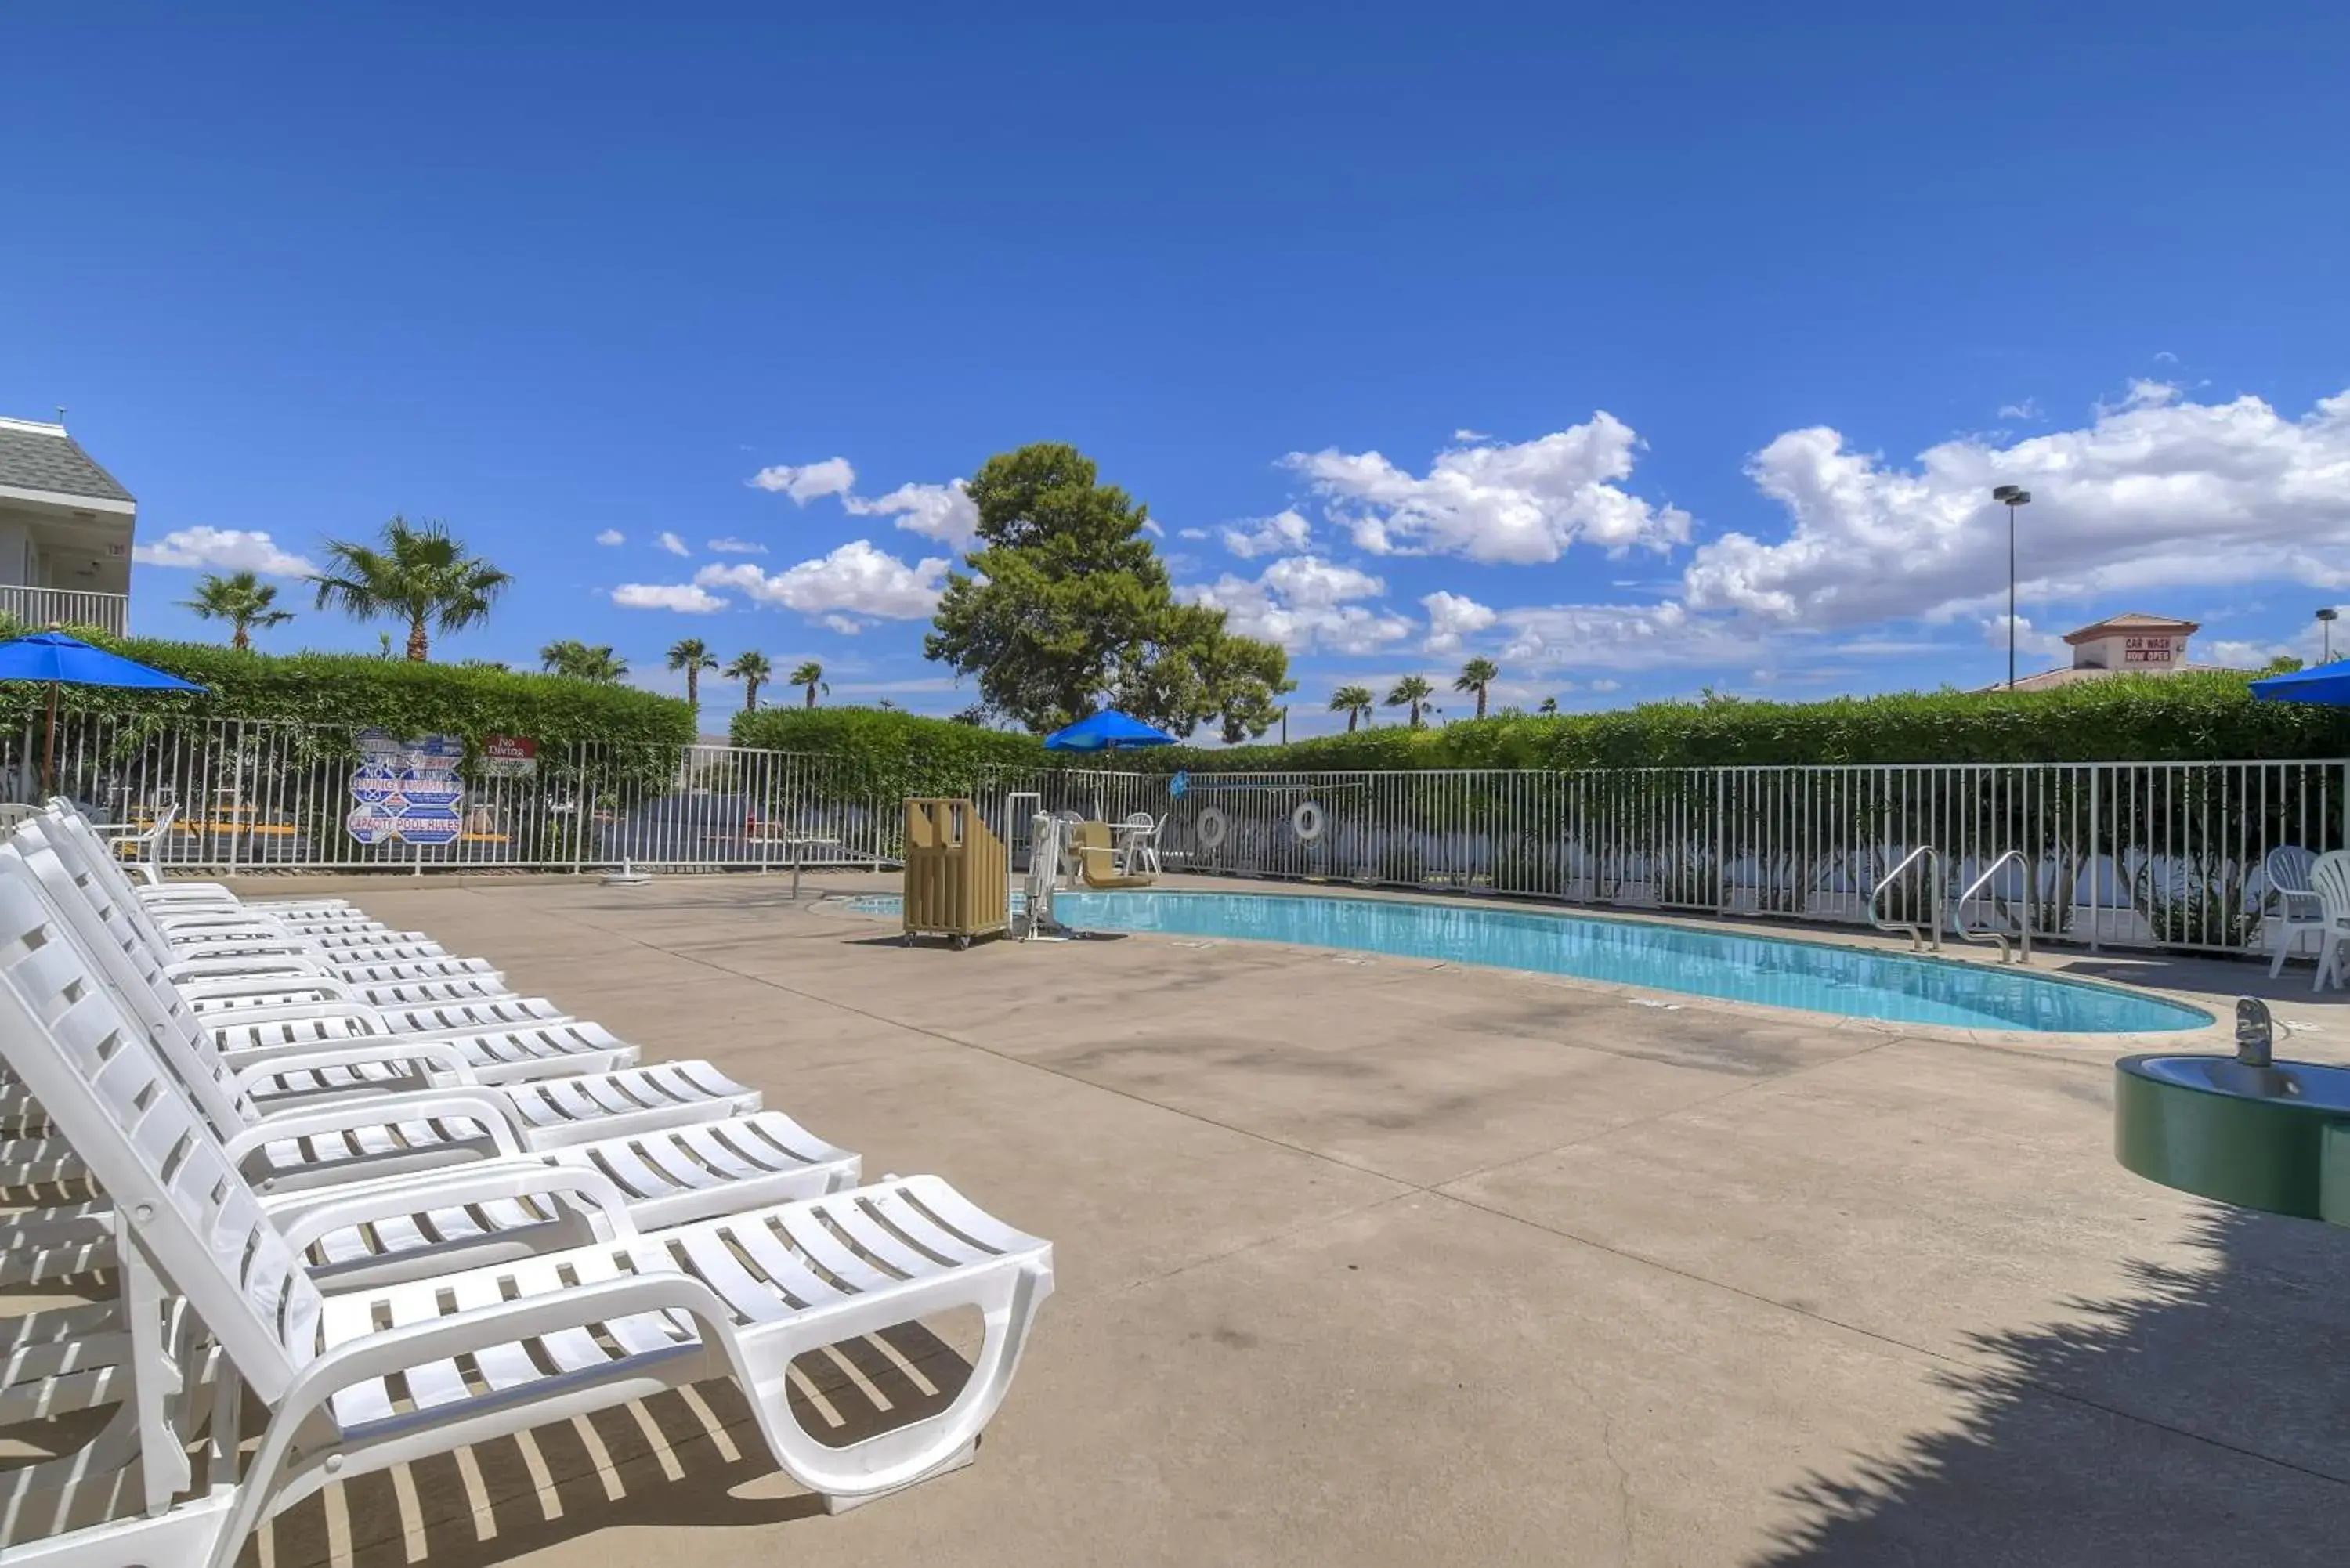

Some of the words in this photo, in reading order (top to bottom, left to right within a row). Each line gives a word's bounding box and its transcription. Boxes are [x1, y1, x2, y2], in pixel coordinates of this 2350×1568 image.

[2126, 638, 2142, 649] CAR
[2147, 638, 2170, 649] WASH
[2149, 652, 2169, 660] OPEN
[499, 738, 515, 747] No
[488, 745, 524, 757] Diving
[366, 768, 383, 778] NO
[352, 779, 394, 790] DIVING
[397, 819, 425, 830] POOL
[427, 819, 461, 830] RULES
